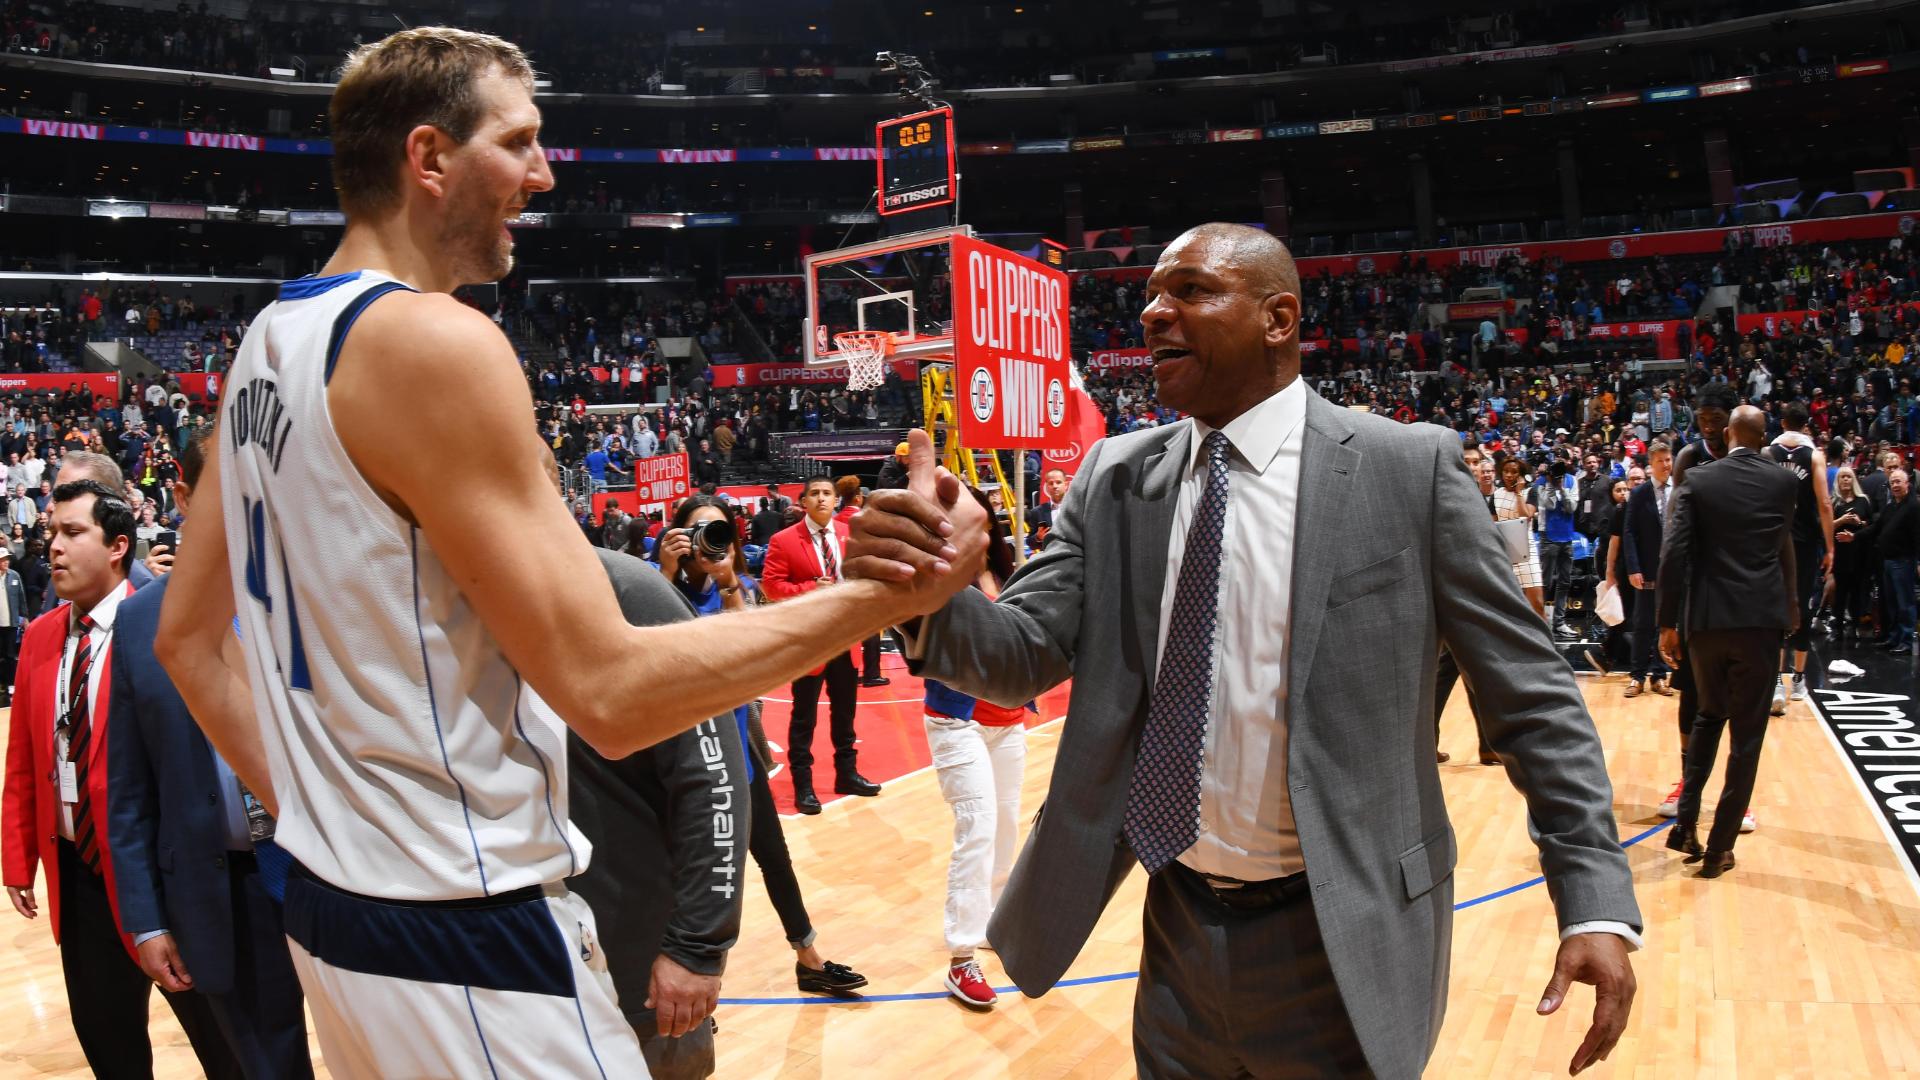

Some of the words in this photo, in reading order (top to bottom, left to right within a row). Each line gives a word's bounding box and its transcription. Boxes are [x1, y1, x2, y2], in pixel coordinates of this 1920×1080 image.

[25, 119, 98, 139] WIN
[899, 122, 931, 147] 0.0
[1279, 126, 1316, 136] DELTA
[187, 131, 259, 150] WIN
[660, 149, 733, 162] WIN
[900, 184, 948, 204] TISSOT
[968, 250, 1063, 362] CLIPPERS
[1000, 357, 1045, 438] WIN!
[790, 441, 846, 449] AMERICAN
[640, 455, 683, 483] CLIPPERS
[651, 479, 674, 501] WIN!
